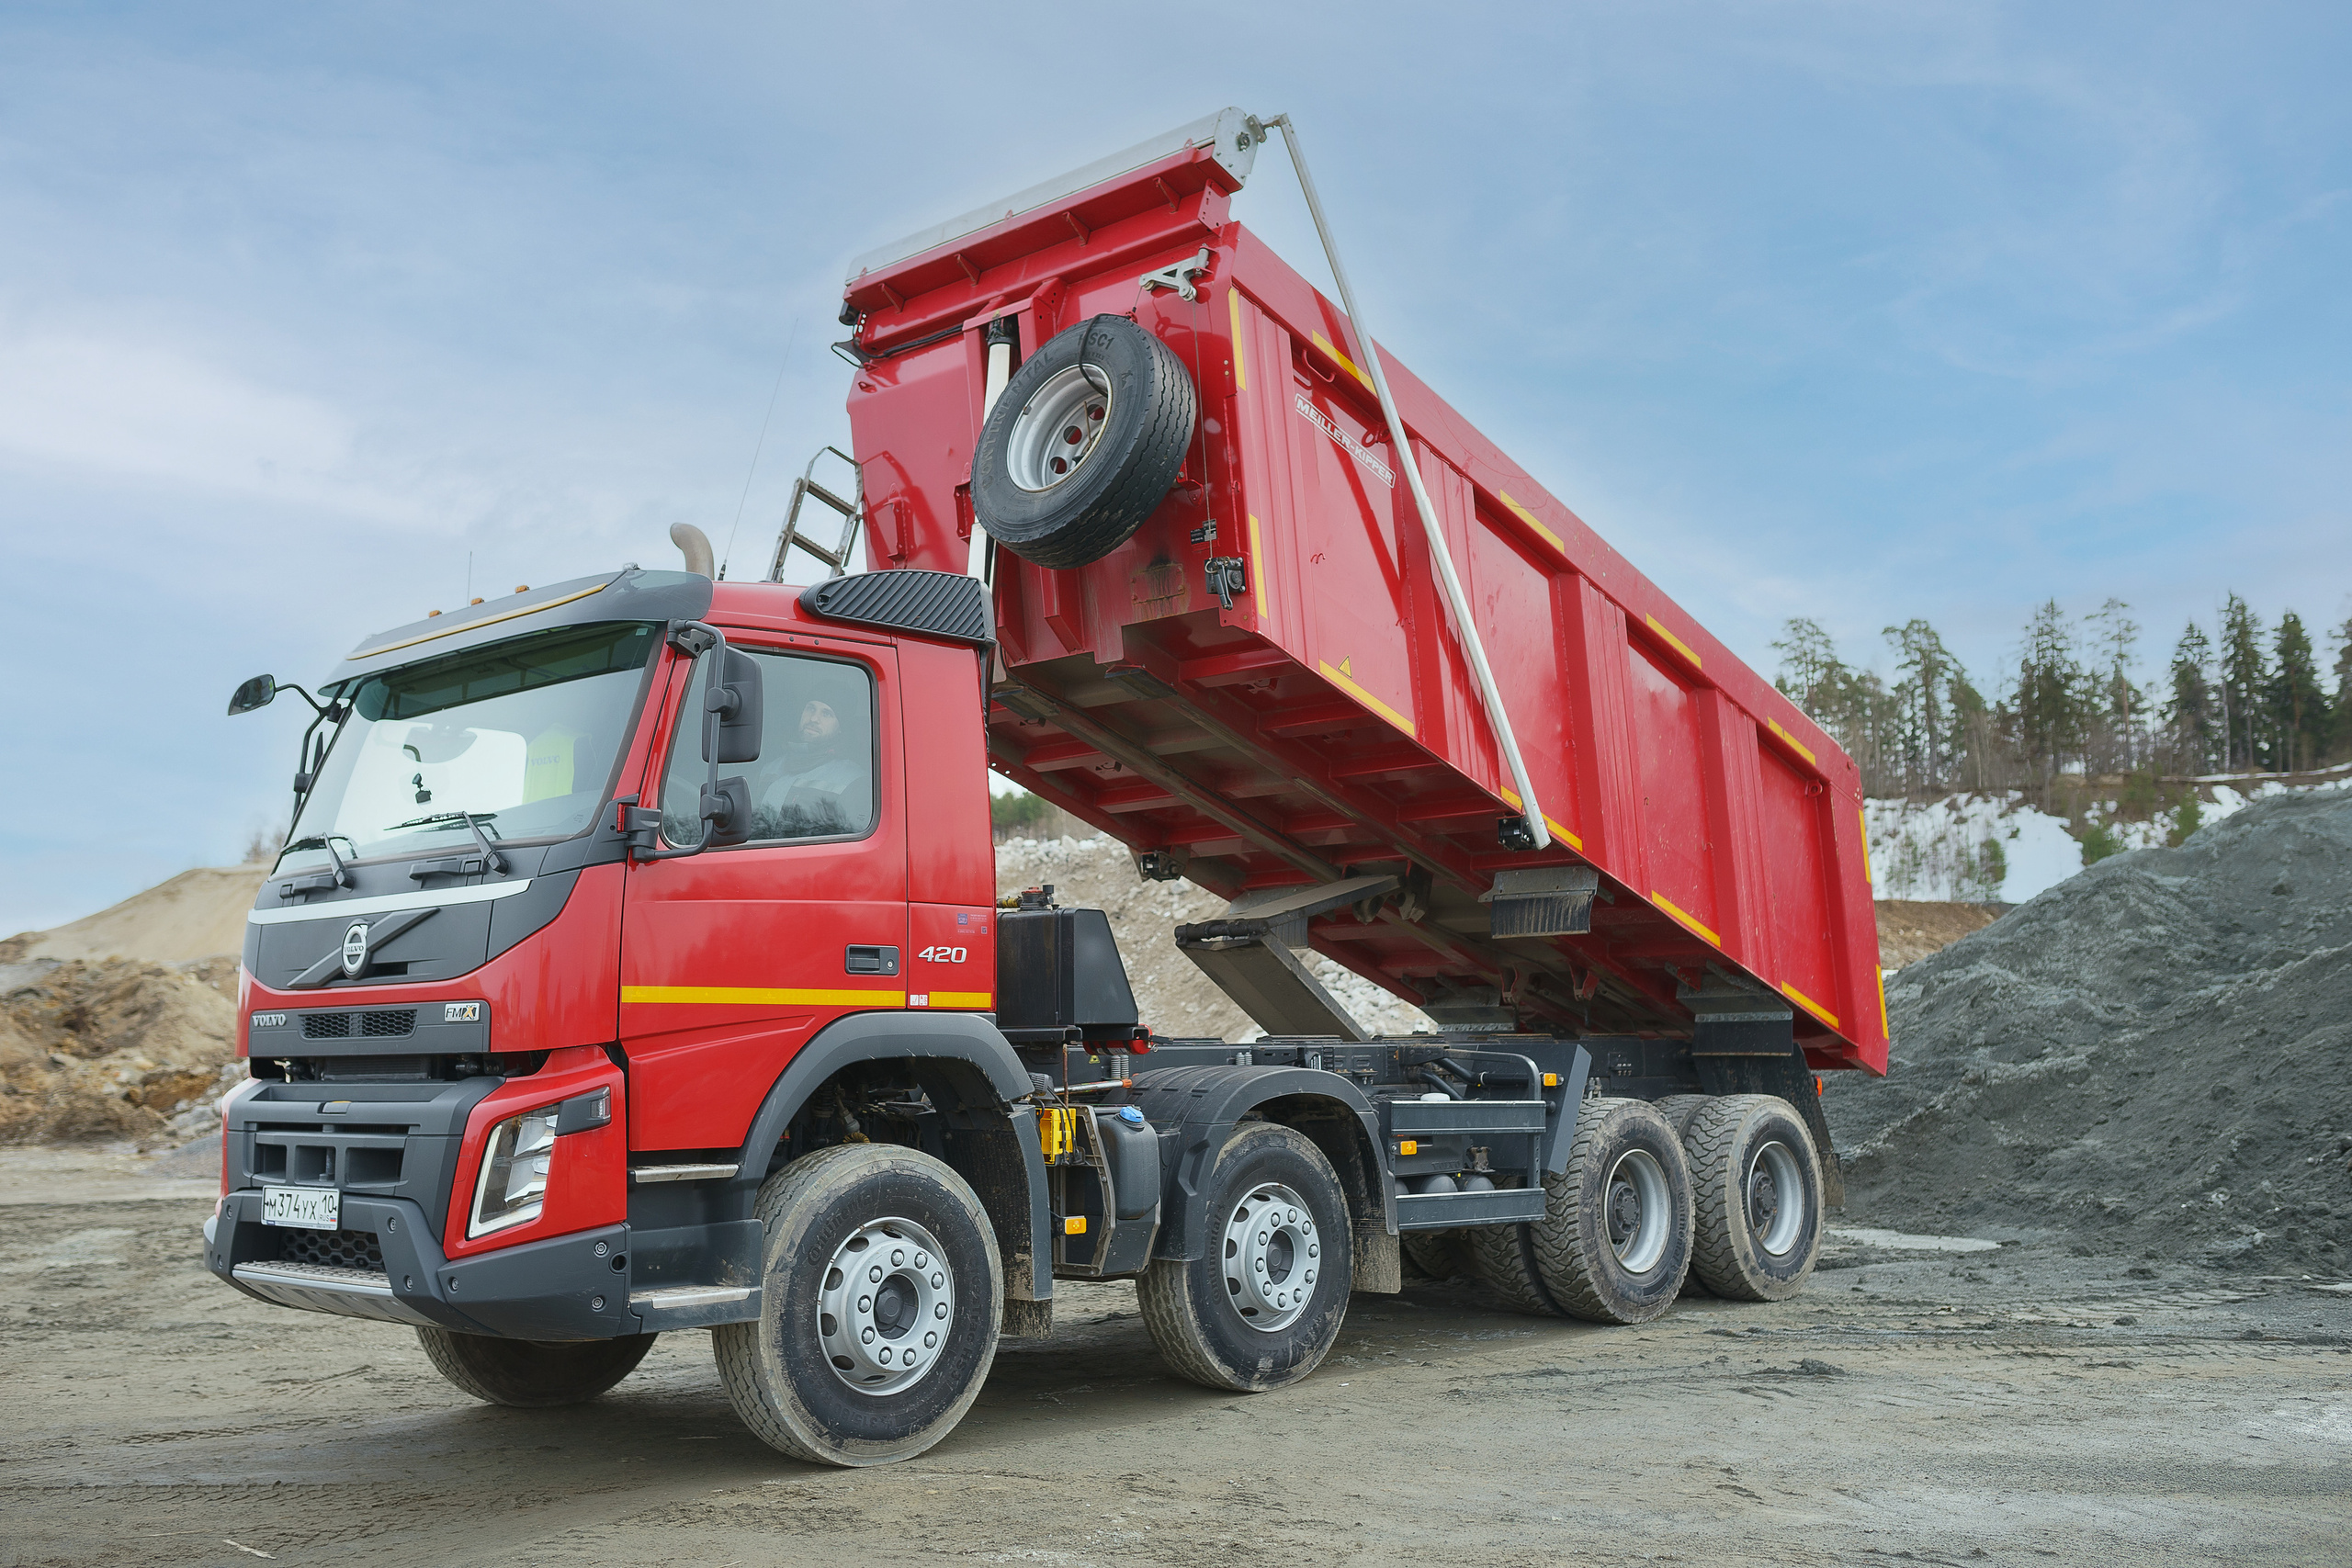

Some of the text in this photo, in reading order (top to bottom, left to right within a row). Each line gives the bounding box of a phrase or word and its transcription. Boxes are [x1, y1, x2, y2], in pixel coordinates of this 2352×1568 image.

[1296, 399, 1393, 483] MEILLER-KIPPER
[530, 755, 560, 767] VOLVO
[918, 945, 967, 964] 420
[252, 1013, 287, 1027] VOLVO
[322, 1194, 334, 1213] 10
